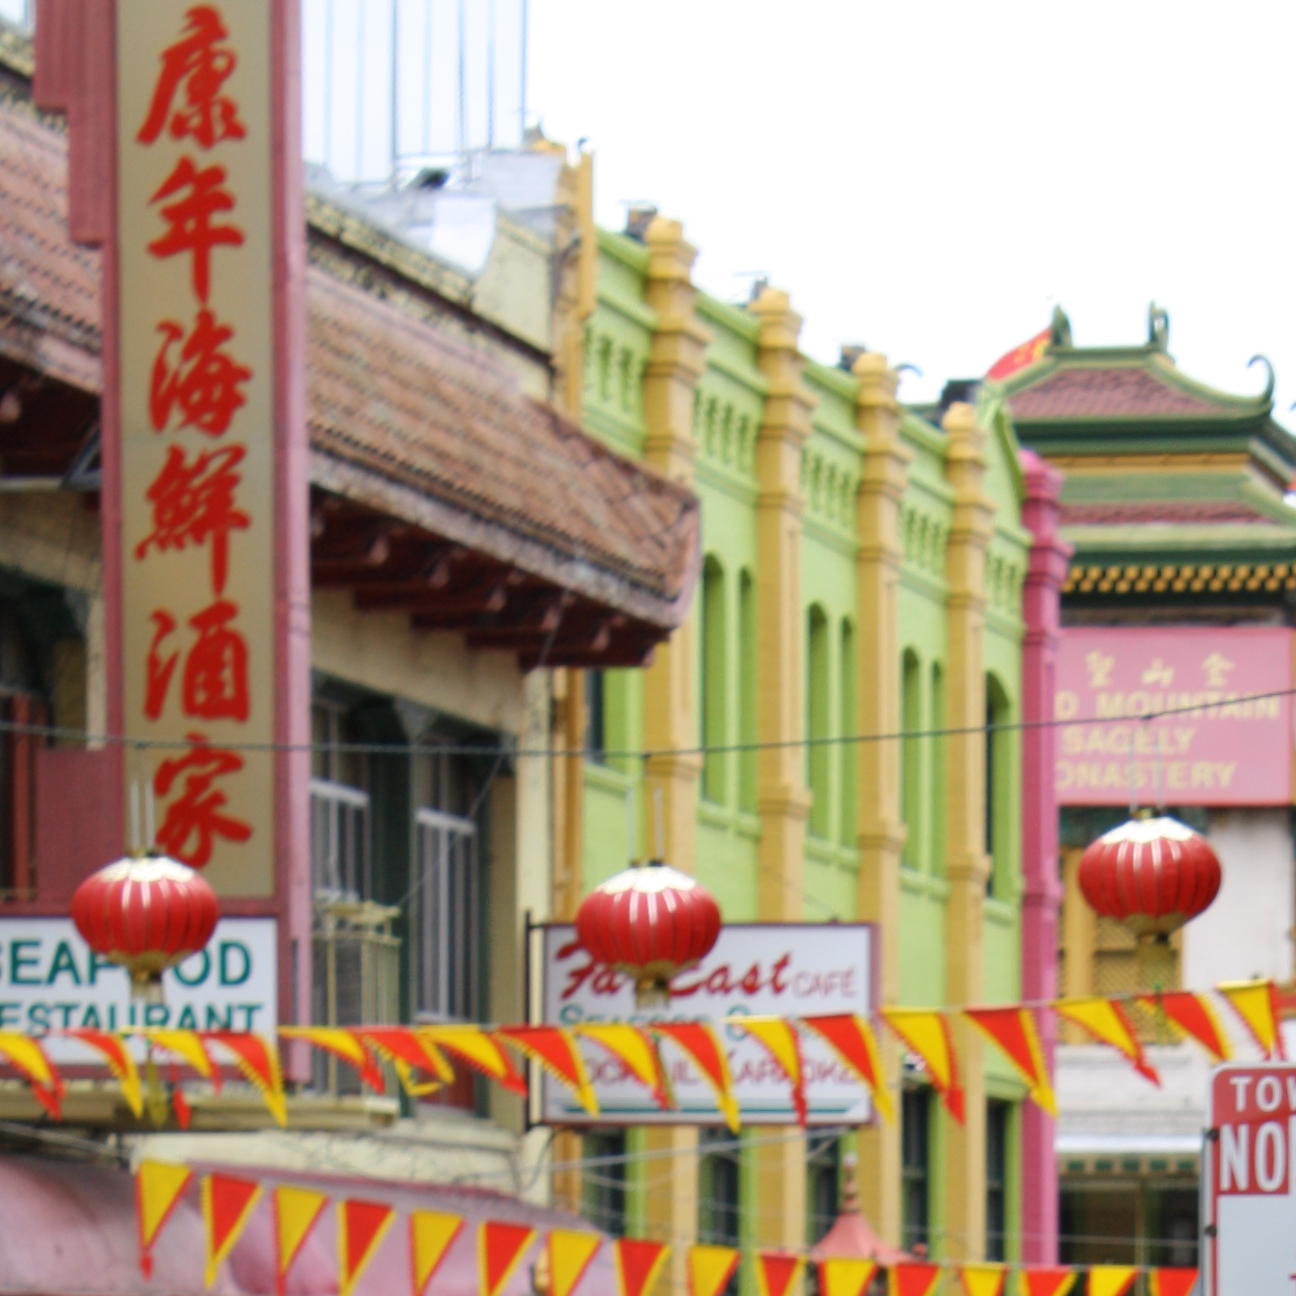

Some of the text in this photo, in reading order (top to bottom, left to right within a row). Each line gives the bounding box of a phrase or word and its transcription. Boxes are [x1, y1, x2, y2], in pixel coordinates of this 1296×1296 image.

[1096, 691, 1281, 721] MOUNTAIN
[1061, 727, 1195, 756] SAGELY
[1055, 761, 1238, 790] ONASTERY
[0, 940, 252, 986] EAFOD
[1219, 1120, 1286, 1193] NO
